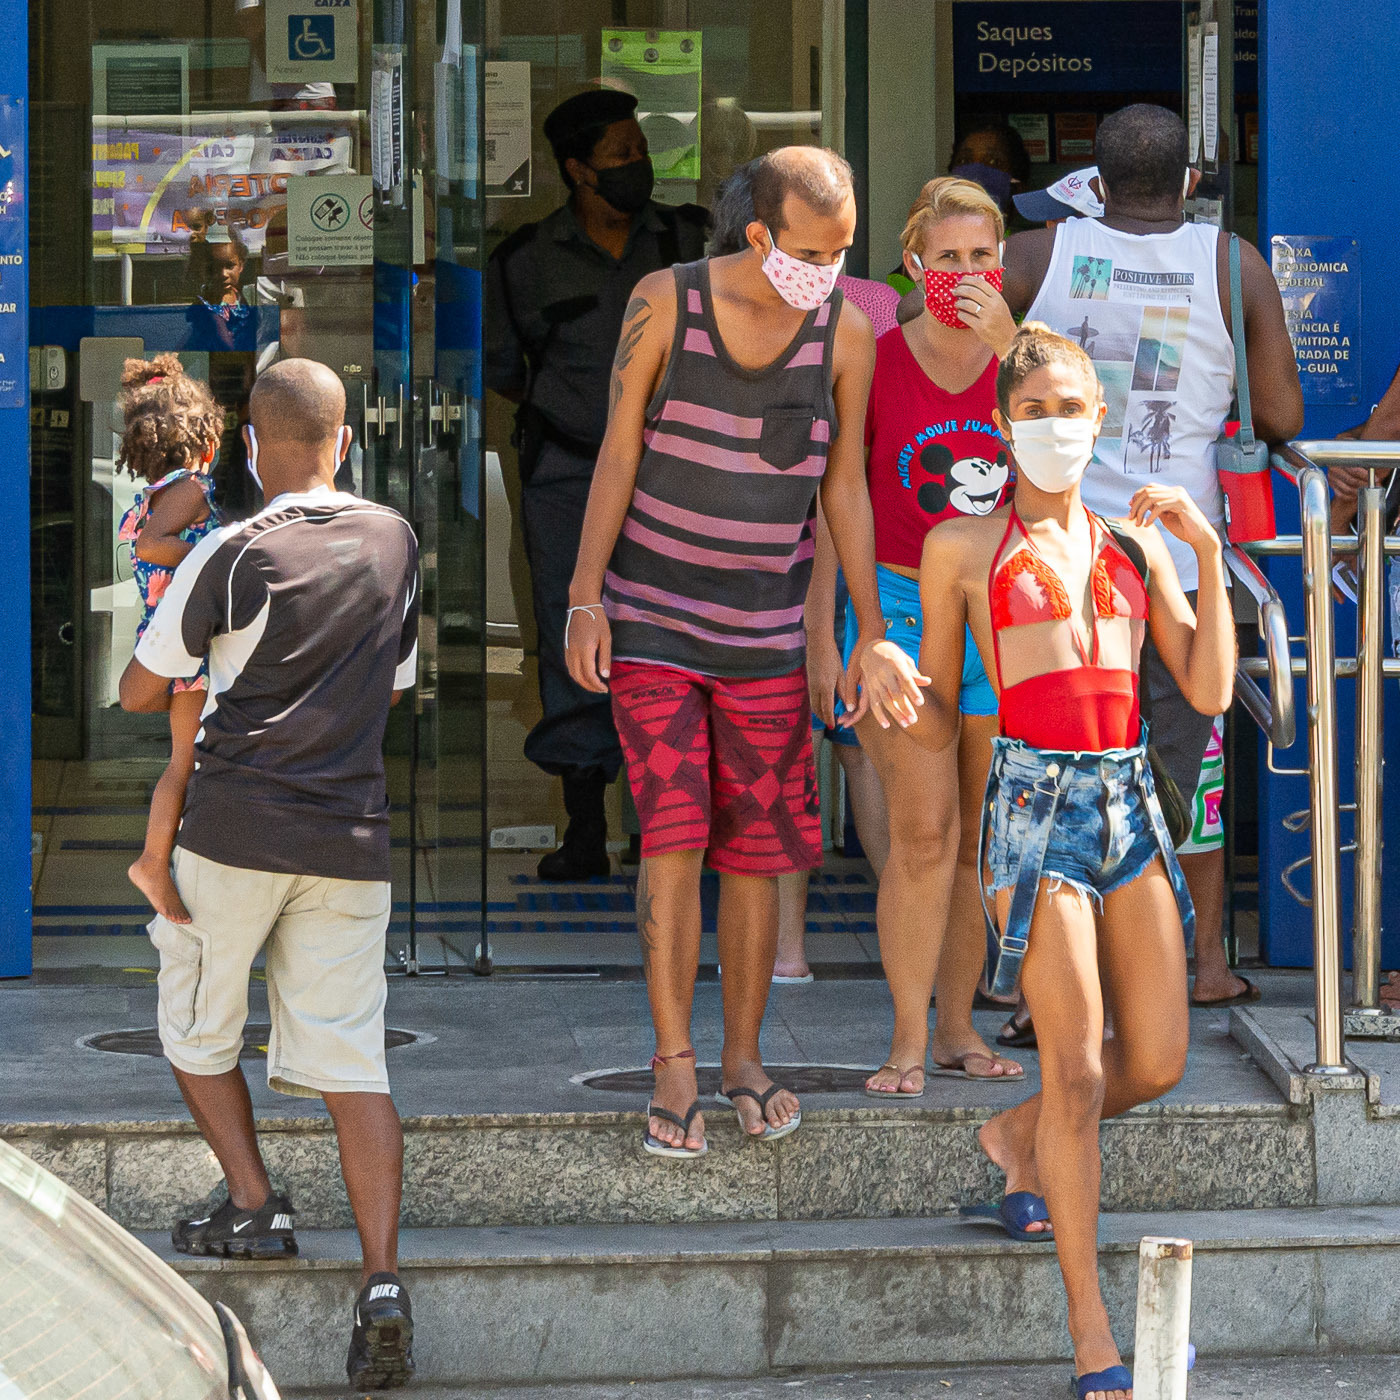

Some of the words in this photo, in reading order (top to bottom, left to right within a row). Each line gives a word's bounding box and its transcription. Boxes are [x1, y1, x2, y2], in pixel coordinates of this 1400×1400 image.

[315, 0, 350, 7] CAIXA
[1235, 6, 1258, 17] Tran
[977, 21, 1053, 46] Saques
[979, 52, 1092, 78] Depósitos
[1277, 248, 1312, 257] CAIXA
[1115, 269, 1161, 284] POSITIVE
[1165, 273, 1195, 285] VIBES
[1276, 277, 1325, 287] FEDERAL
[1285, 310, 1313, 319] ESTA
[1333, 320, 1340, 332] É
[1291, 336, 1338, 346] RMITIDA
[1341, 336, 1350, 346] A
[1294, 350, 1330, 360] TRADA
[1334, 350, 1349, 360] DE
[897, 443, 915, 489] MICKEY
[914, 419, 958, 445] MOUSE
[963, 419, 1004, 440] SUMM
[270, 1213, 293, 1230] NIK
[369, 1283, 400, 1301] NIKE
